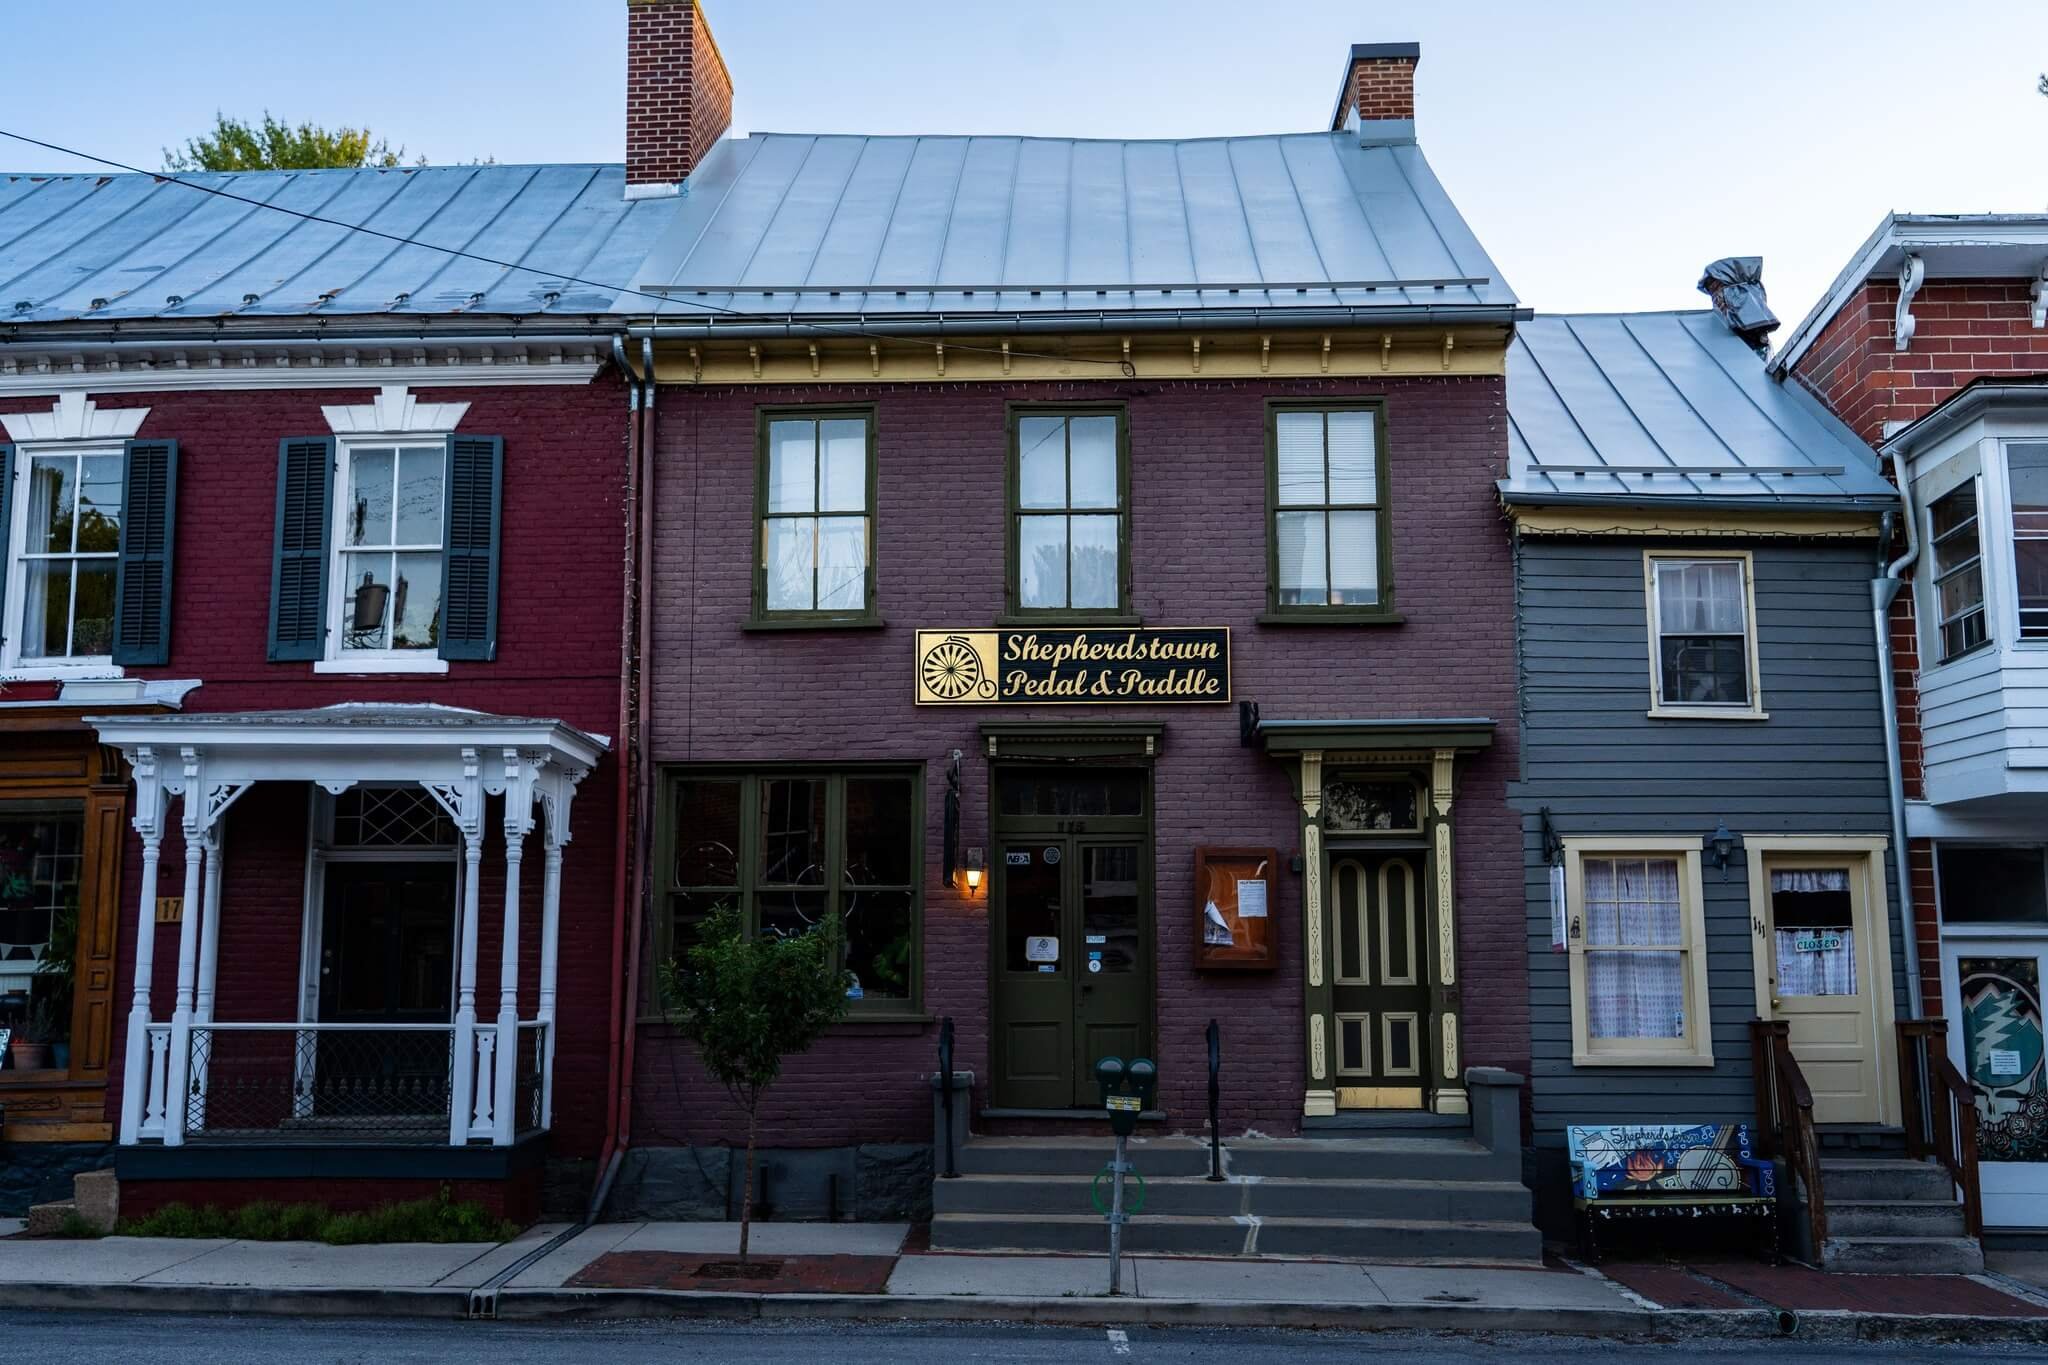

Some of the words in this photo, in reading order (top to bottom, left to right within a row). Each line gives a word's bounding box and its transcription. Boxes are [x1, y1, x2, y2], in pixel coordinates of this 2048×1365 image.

[1003, 633, 1220, 668] Shepherdstown
[1002, 668, 1088, 696] Pedal
[1091, 669, 1114, 695] &
[1116, 667, 1220, 695] Paddle
[1753, 916, 1766, 939] 111
[1797, 938, 1840, 950] CLOSED
